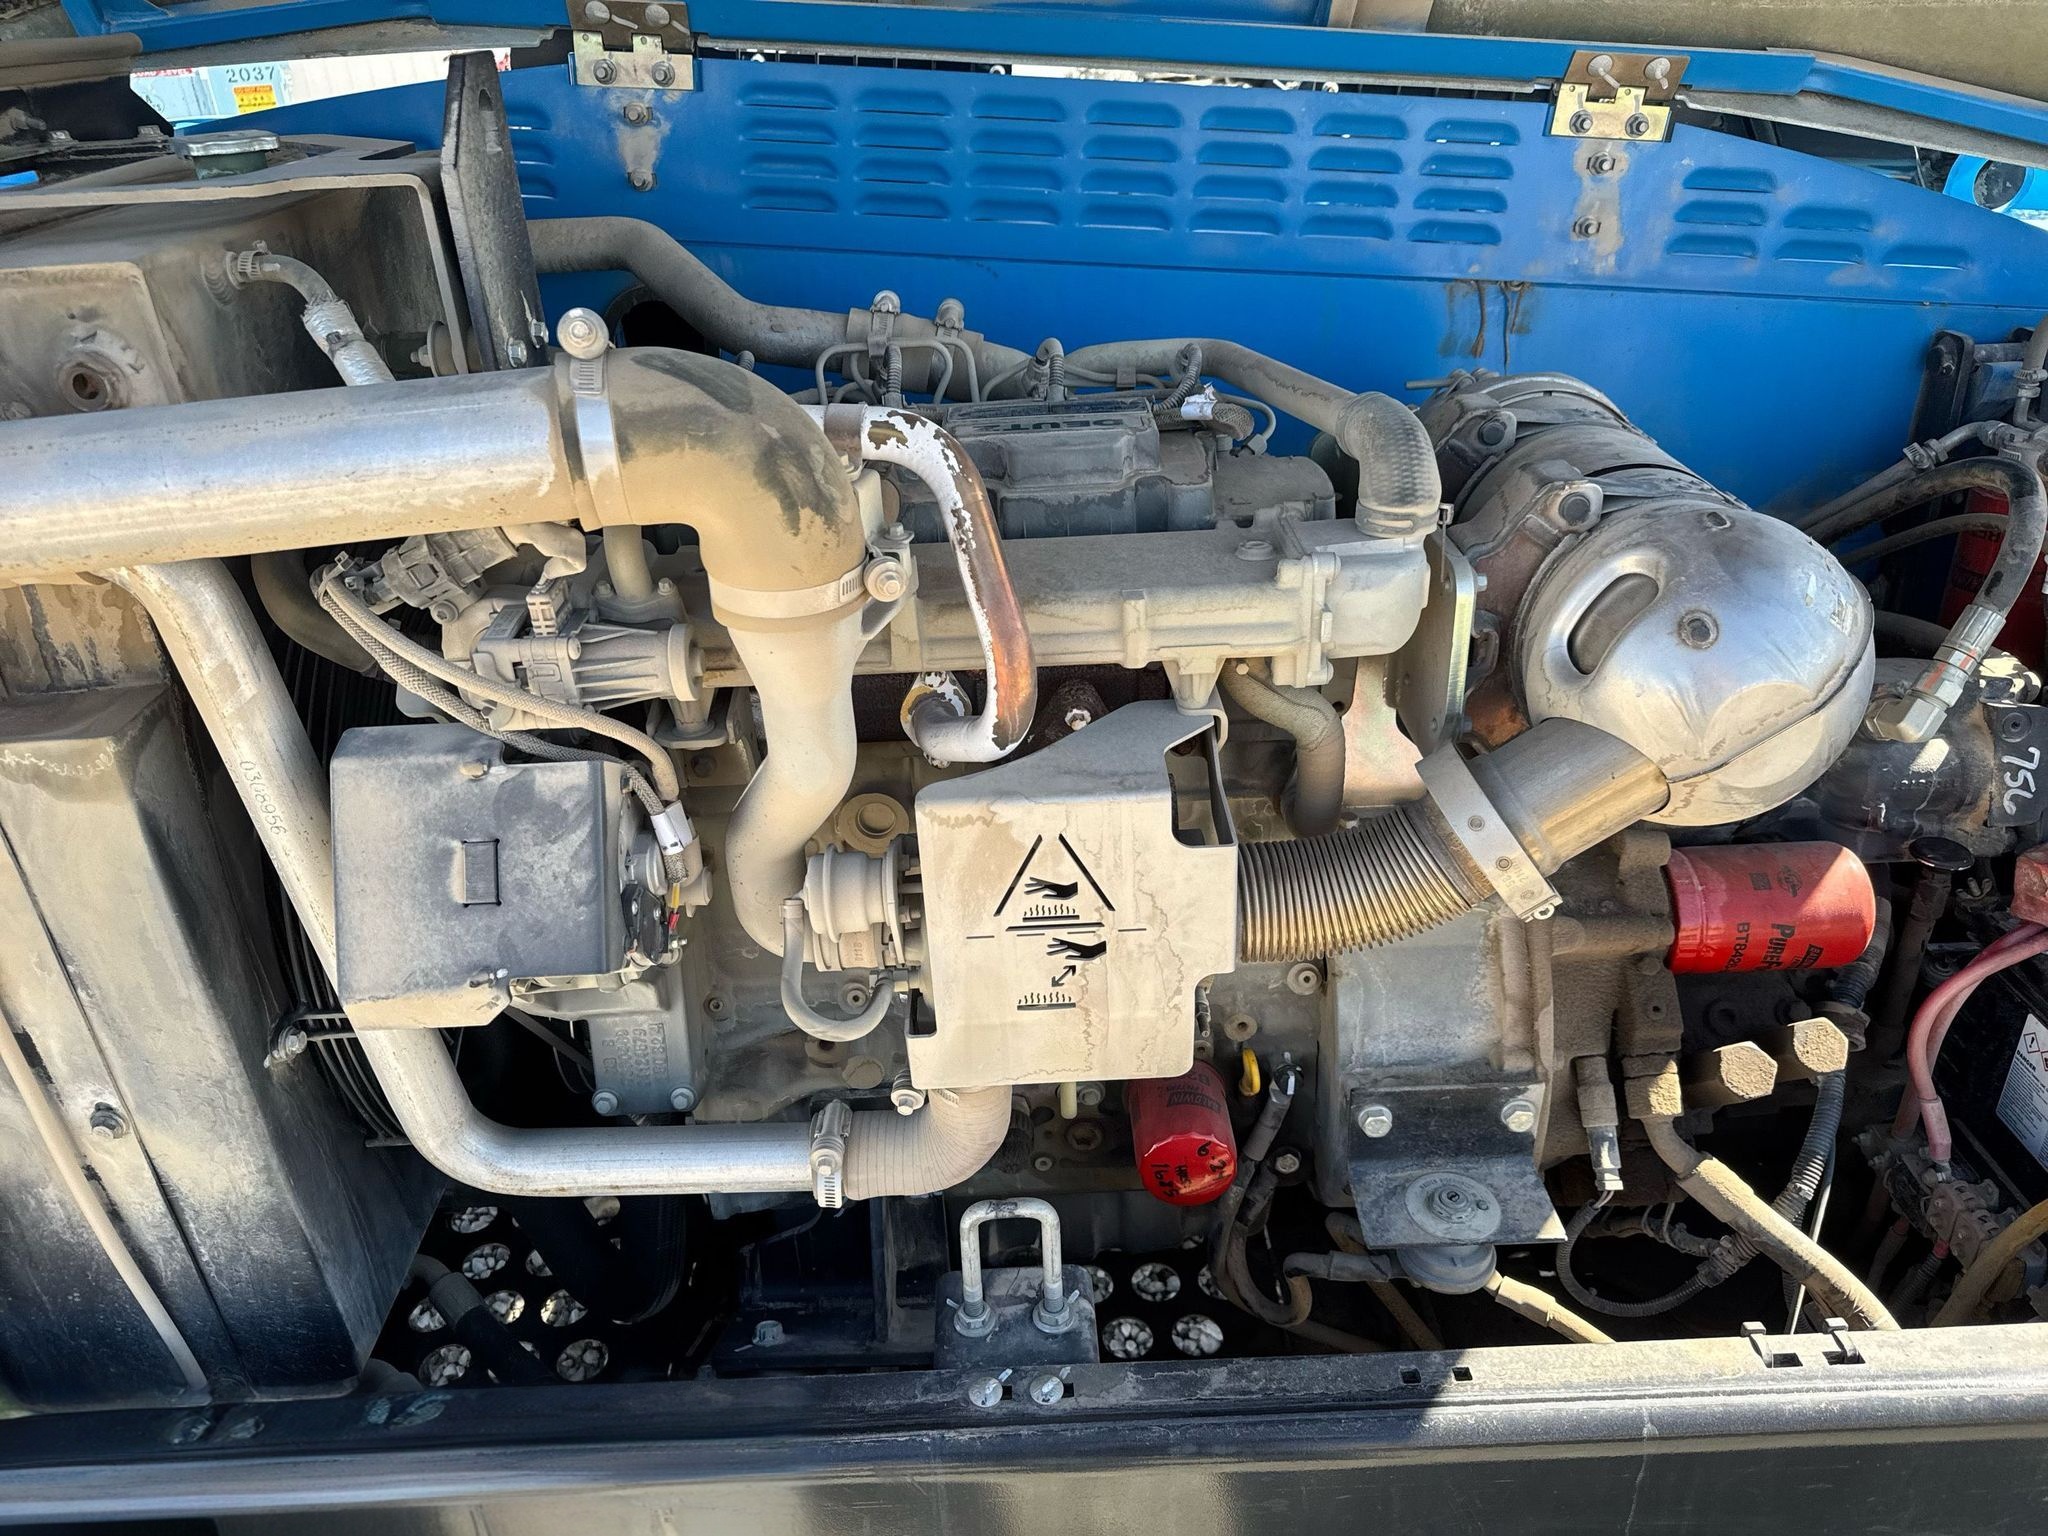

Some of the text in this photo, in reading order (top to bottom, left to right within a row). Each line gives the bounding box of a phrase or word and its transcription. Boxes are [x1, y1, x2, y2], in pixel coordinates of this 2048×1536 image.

[226, 66, 275, 83] 2037
[972, 418, 1124, 432] DEUTZ
[2016, 1049, 2037, 1072] DANGER
